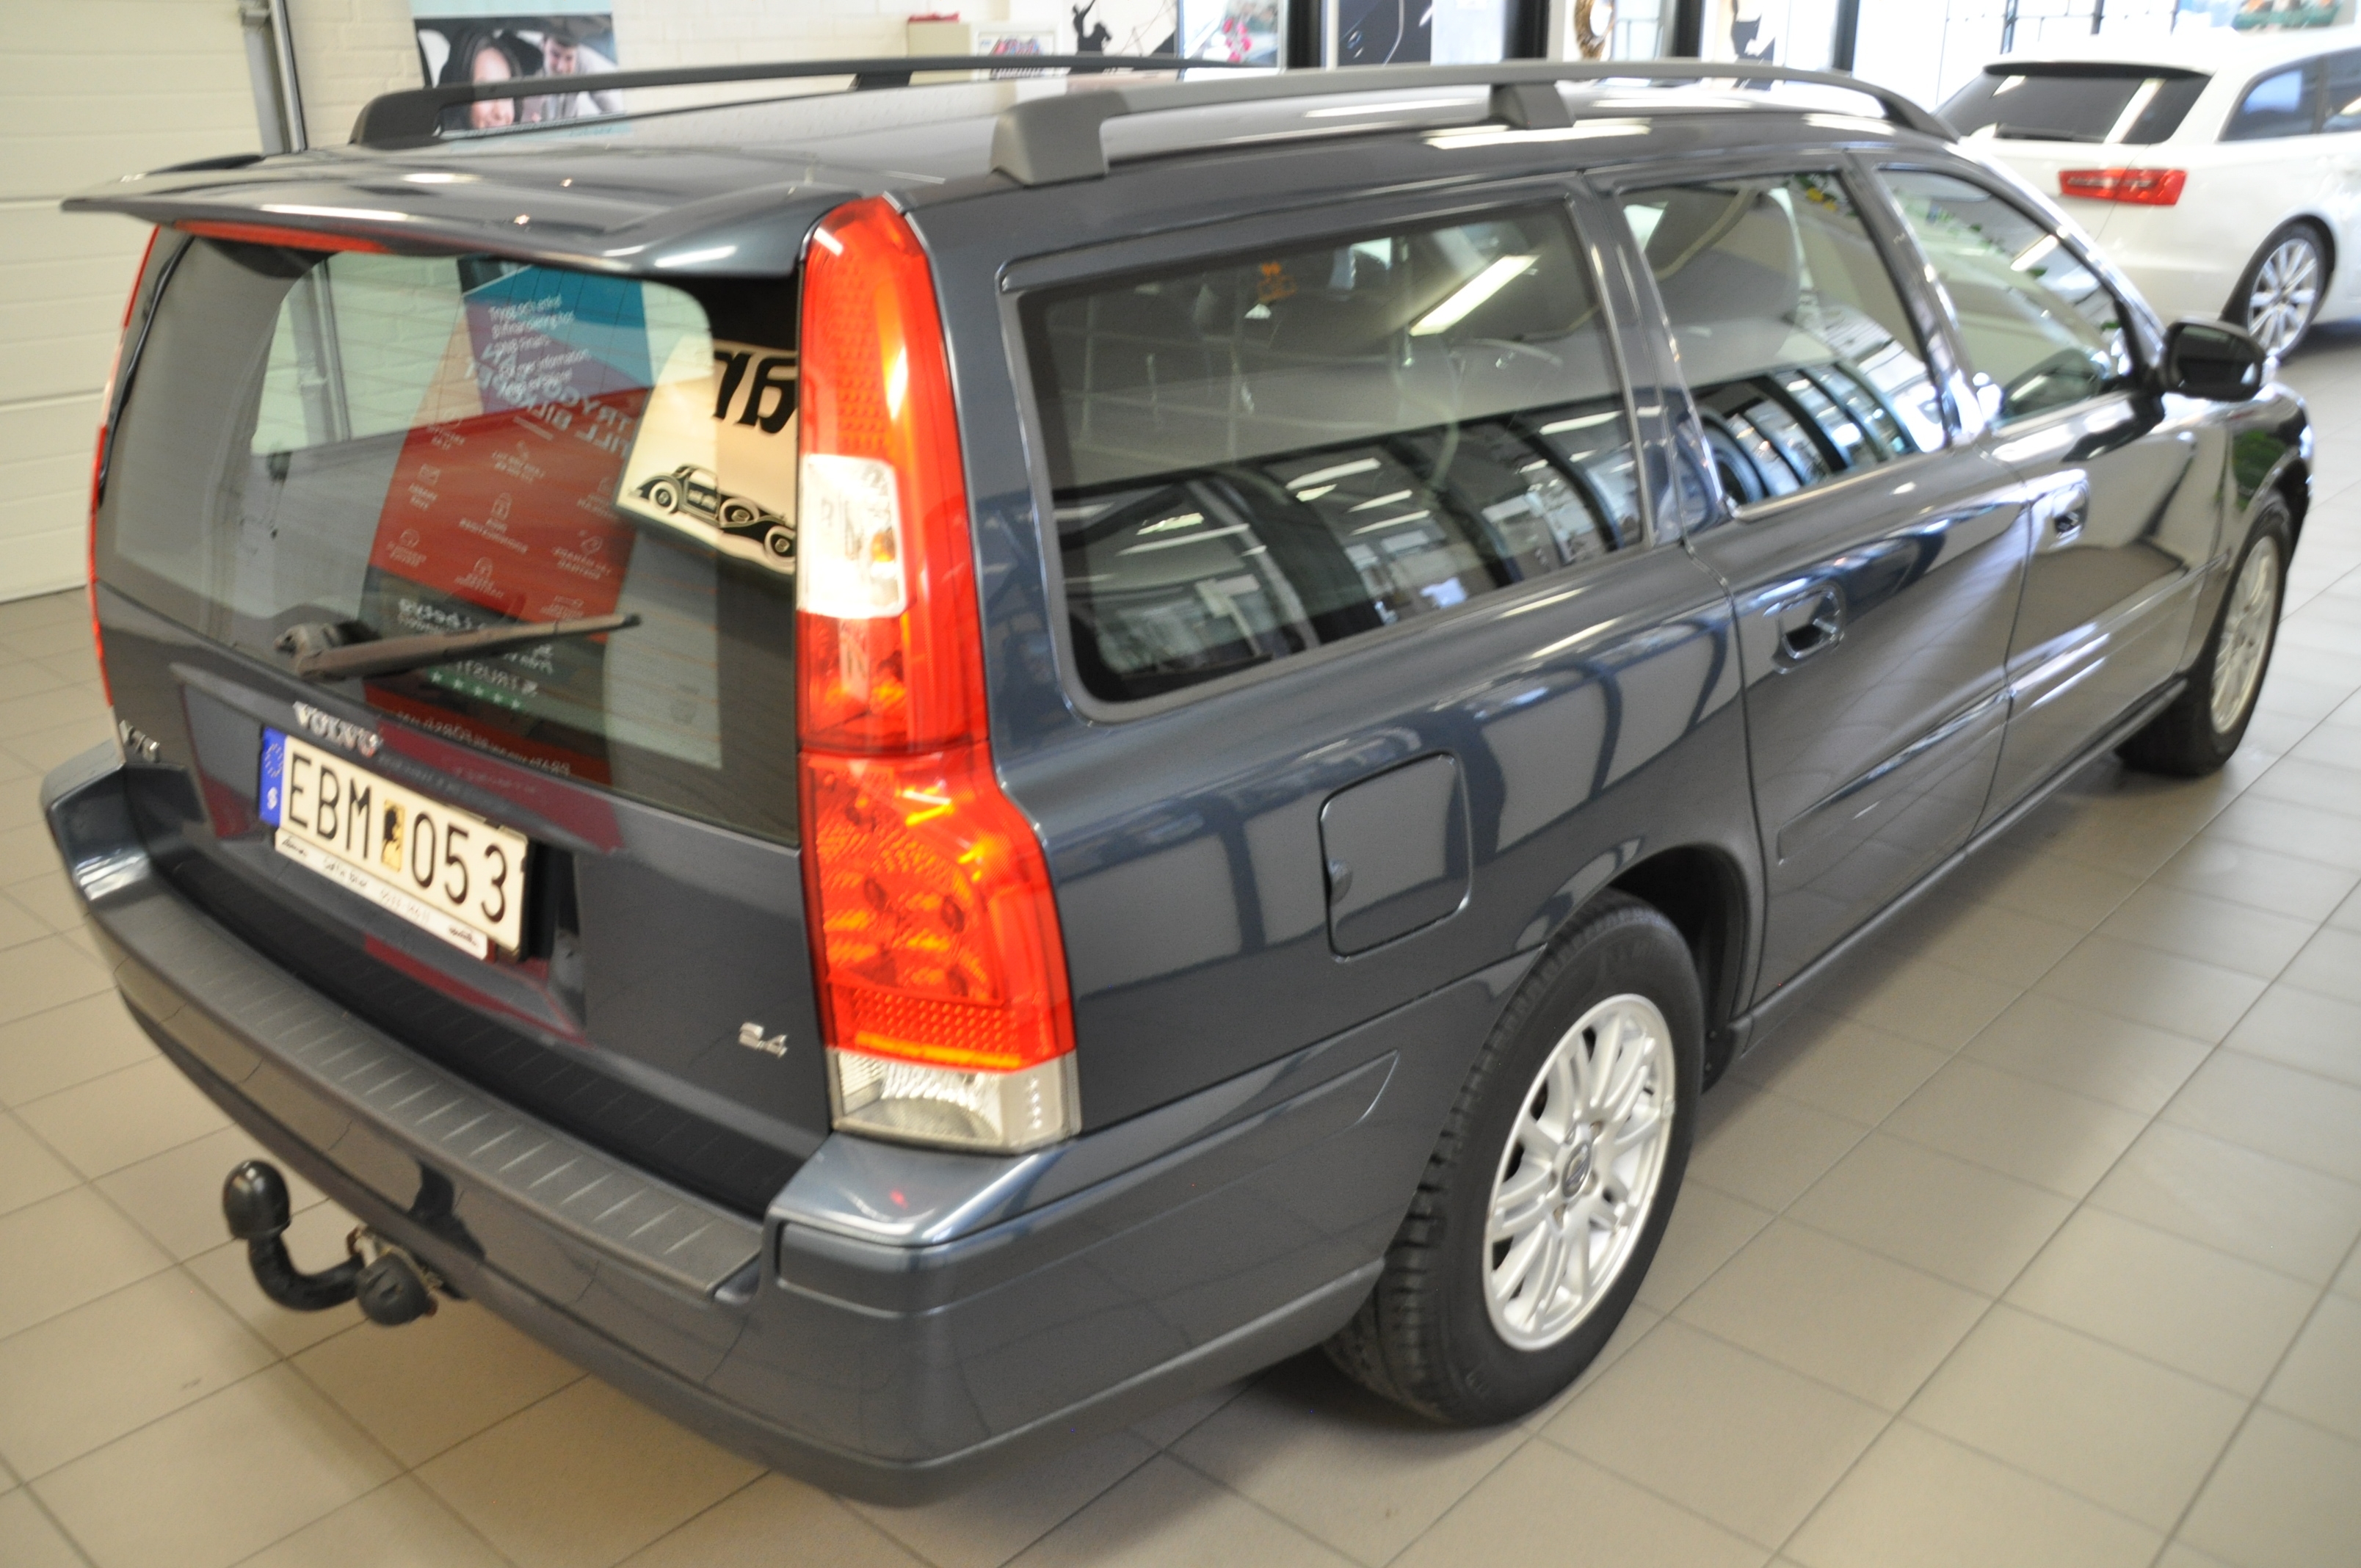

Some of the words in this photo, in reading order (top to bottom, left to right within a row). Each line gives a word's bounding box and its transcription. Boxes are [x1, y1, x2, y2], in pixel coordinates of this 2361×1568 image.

[292, 700, 383, 758] VOLVO
[289, 752, 372, 860] EBM
[411, 811, 507, 923] 053
